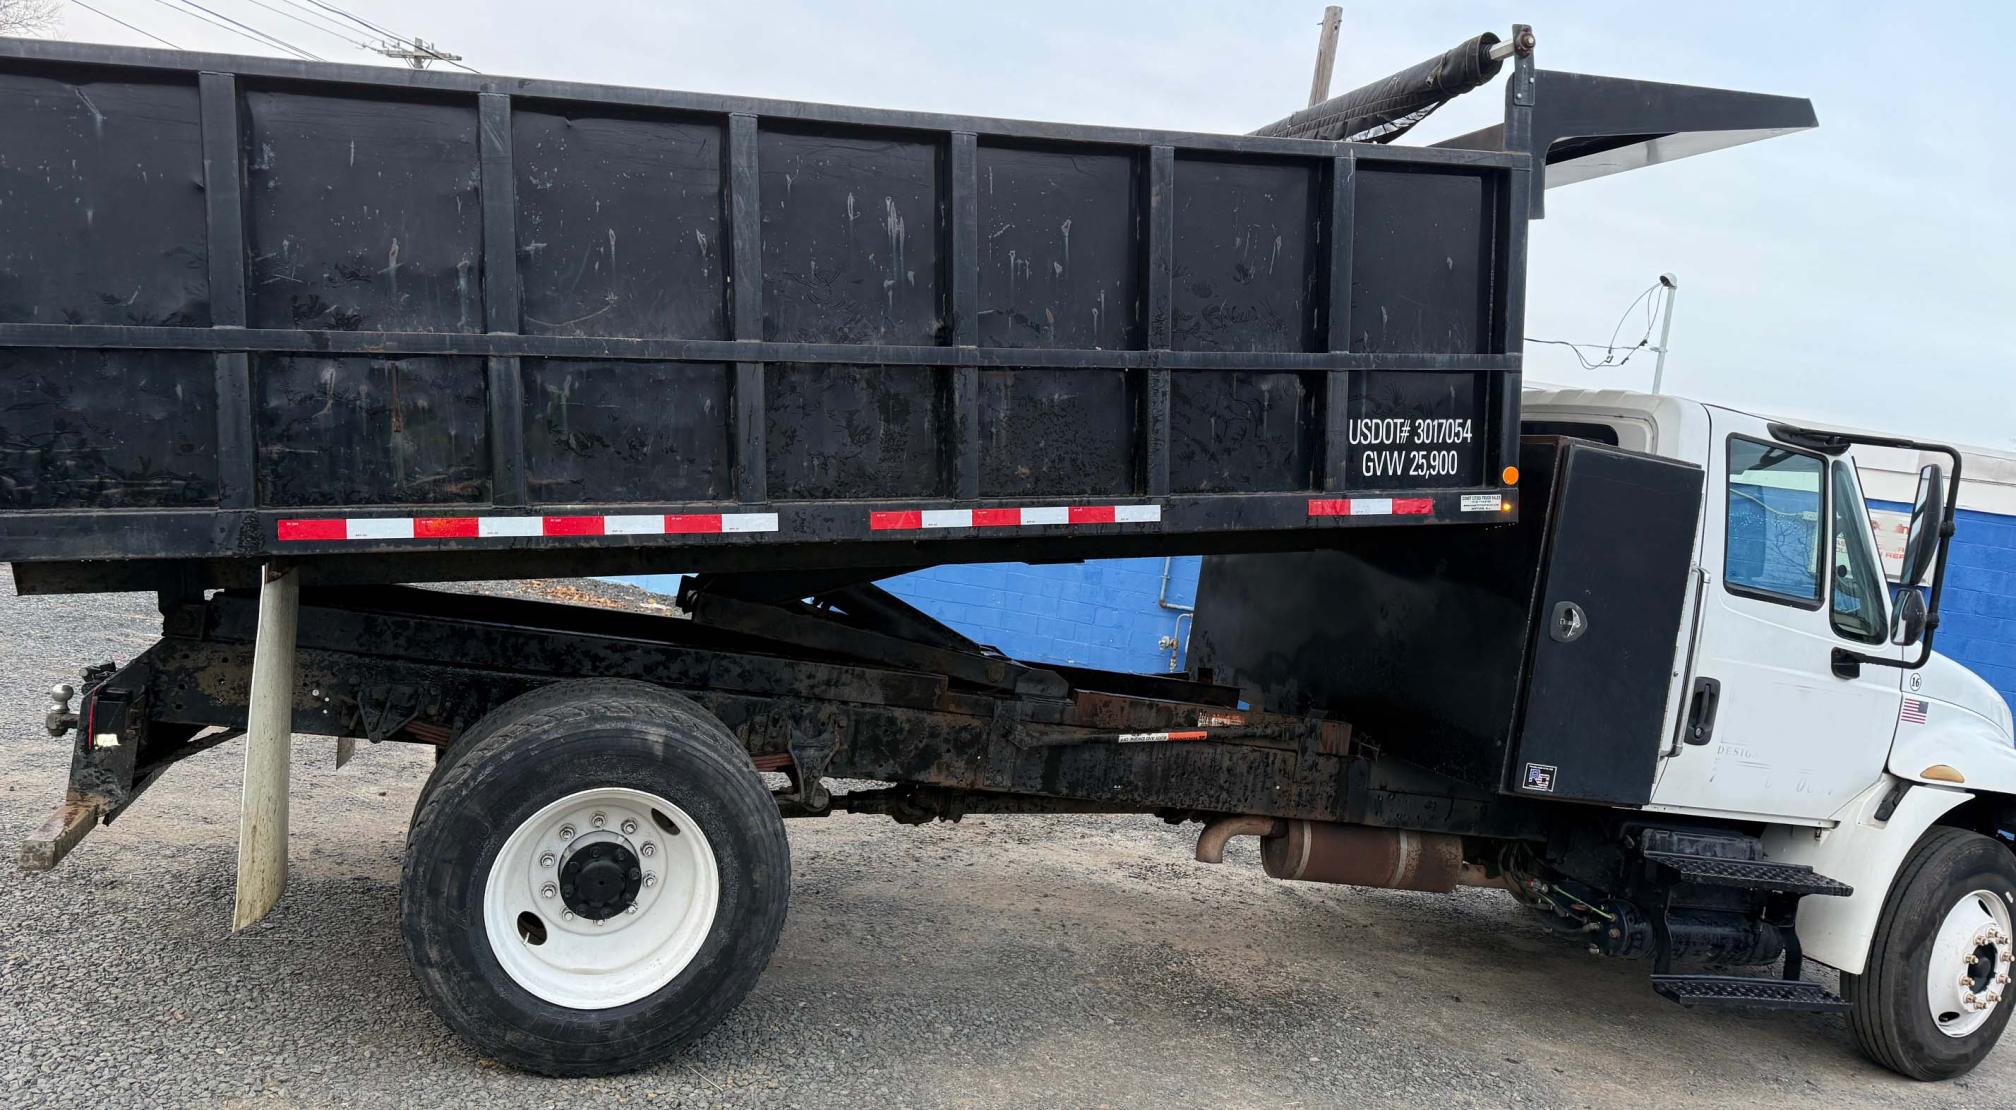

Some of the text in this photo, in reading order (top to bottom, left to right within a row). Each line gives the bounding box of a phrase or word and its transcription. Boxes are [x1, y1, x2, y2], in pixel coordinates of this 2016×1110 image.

[1349, 418, 1473, 445] USDOT# 3017054
[1362, 450, 1458, 479] GVW 25,900
[1911, 676, 1920, 688] 16
